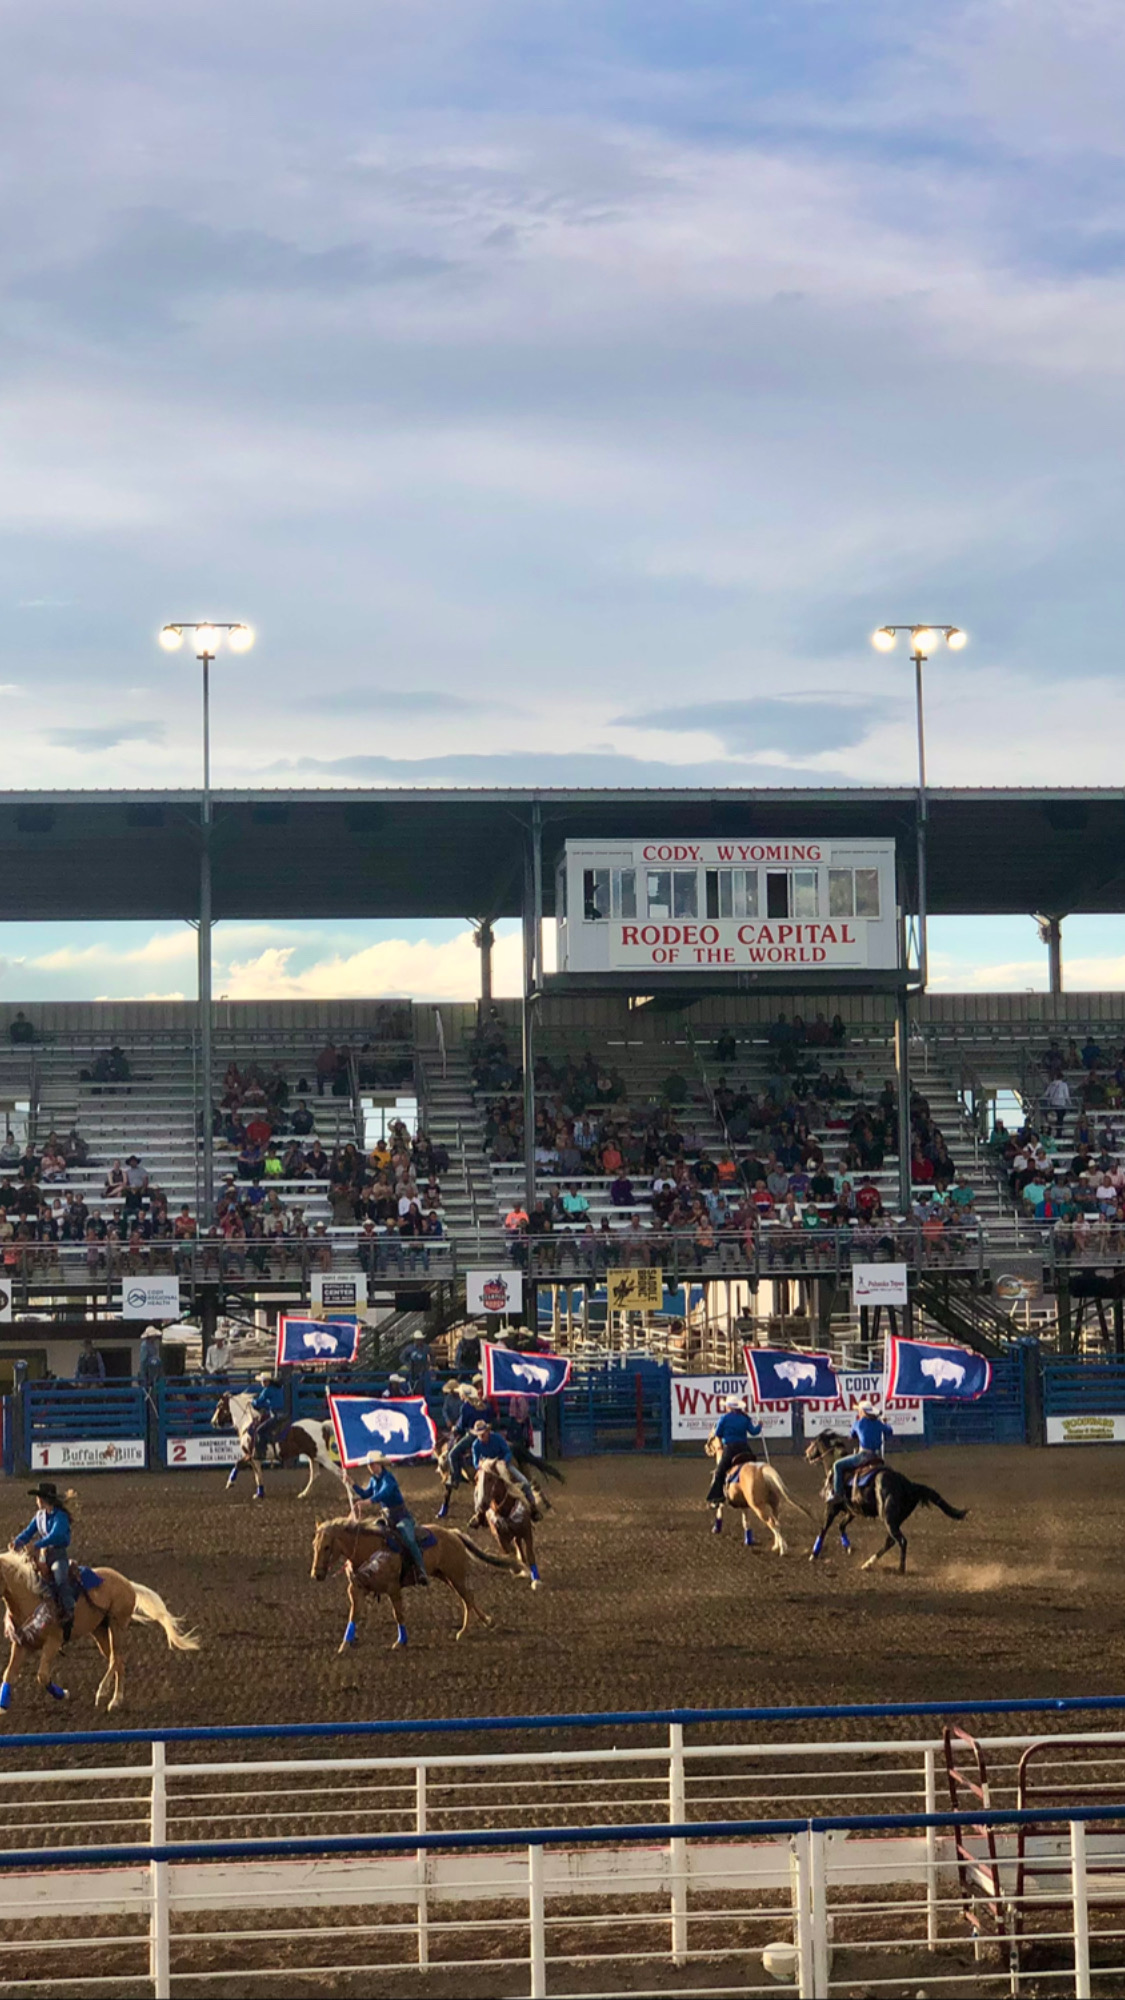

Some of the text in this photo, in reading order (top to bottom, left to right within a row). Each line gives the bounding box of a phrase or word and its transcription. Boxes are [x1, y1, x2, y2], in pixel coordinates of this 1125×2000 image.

[643, 845, 821, 862] CODY, WYOMING
[621, 924, 856, 945] RODEO CAPITAL
[652, 947, 827, 963] OF THE WORLD
[323, 1289, 355, 1297] CENTER
[713, 1380, 748, 1395] CODY
[846, 1377, 880, 1392] CODY
[674, 1384, 789, 1415] WYOING
[40, 1449, 49, 1466] 1
[61, 1447, 106, 1464] Buffalo
[173, 1445, 187, 1462] 2
